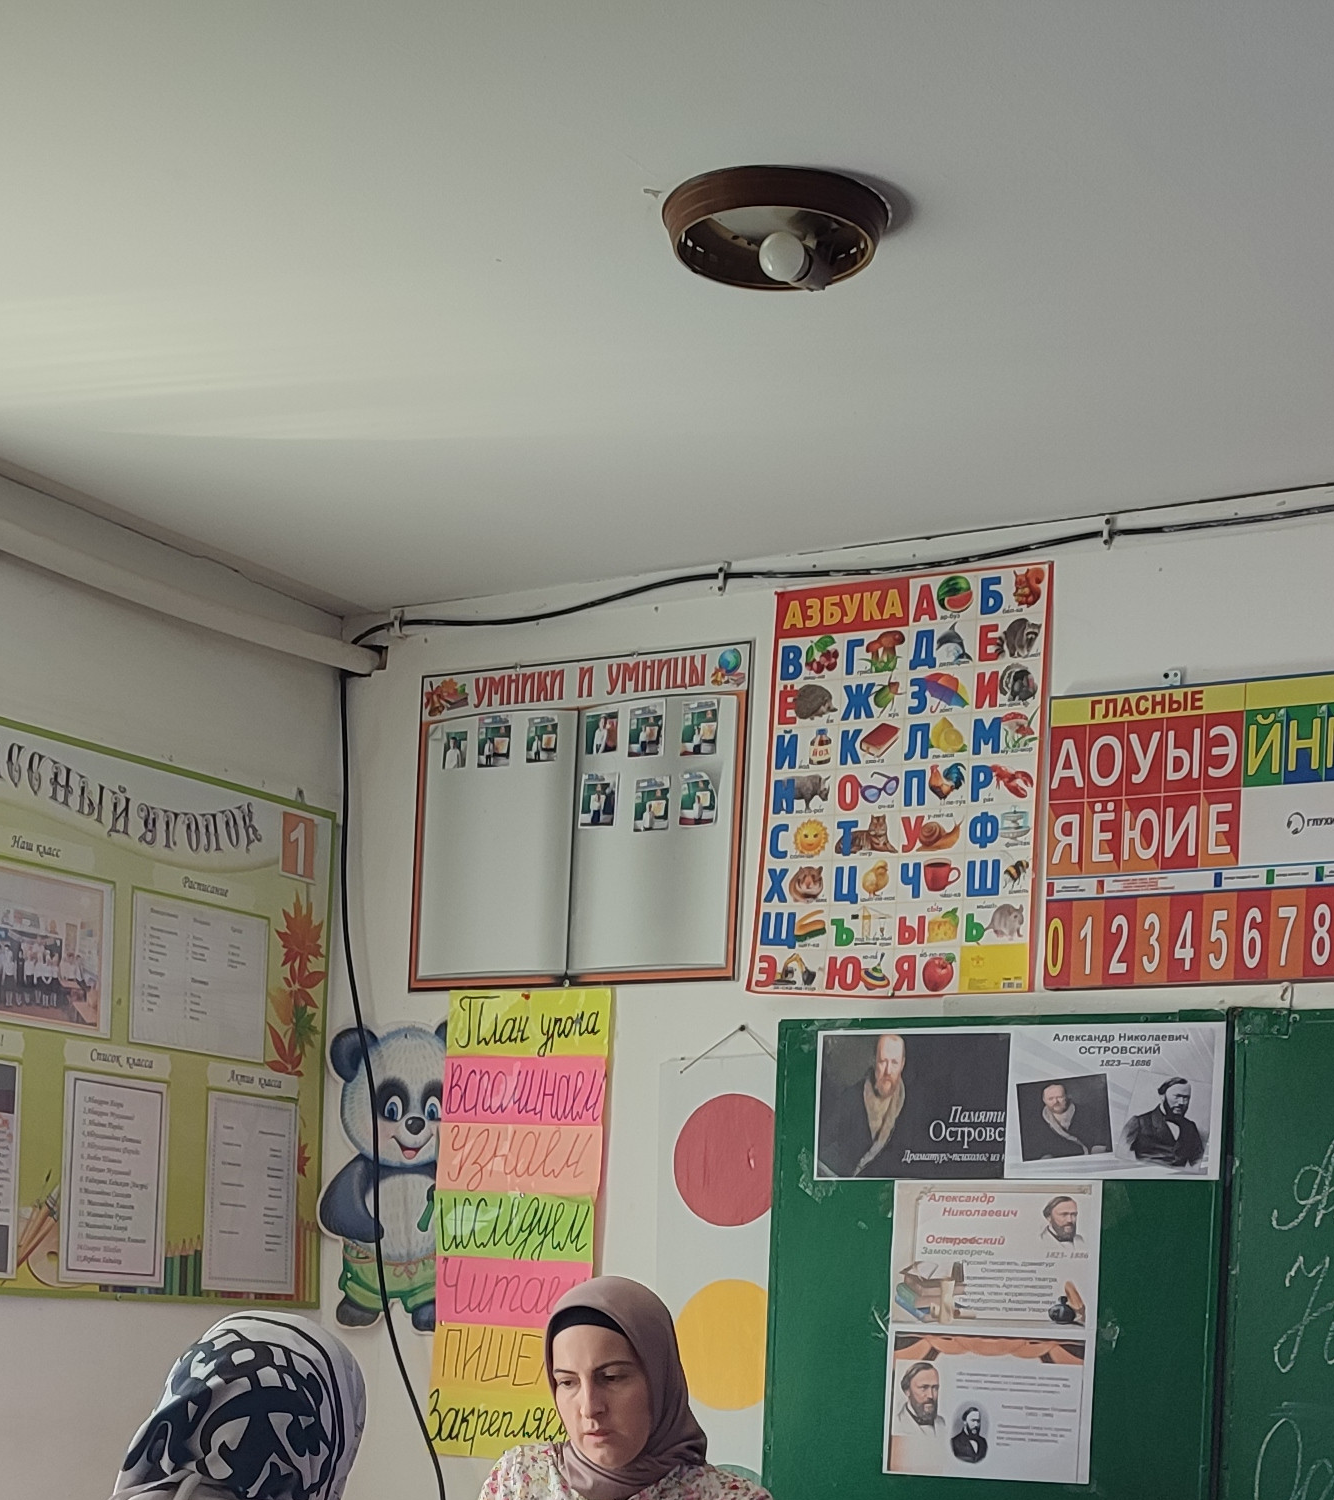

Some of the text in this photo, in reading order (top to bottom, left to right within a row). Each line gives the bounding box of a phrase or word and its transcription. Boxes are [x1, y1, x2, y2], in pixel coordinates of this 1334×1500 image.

[782, 576, 1003, 630] АЗБУКА А Б
[780, 623, 999, 681] В Г Д Е
[473, 653, 707, 709] УМНИКИ И УМНИЦЫ
[778, 670, 999, 725] Ё Ж З И
[1090, 689, 1204, 720] ГЛАСНЫЕ
[774, 716, 1002, 770] Й К Л М
[772, 764, 994, 815] Н О П Р
[11, 834, 61, 859] Наш класс
[137, 802, 263, 854] УГОЛОК
[769, 811, 999, 859] С Т У Ф
[182, 876, 229, 898] Расписание
[763, 859, 1001, 904] Х Ц Ч Ш
[759, 911, 985, 949] Щ Ъ Ы Ь
[1046, 917, 1064, 977] 0
[1079, 916, 1093, 975] 1
[1108, 914, 1129, 974] 2
[1141, 912, 1160, 973] 3
[1174, 910, 1194, 971] 4
[1208, 909, 1228, 970] 5
[1242, 907, 1263, 969] 6
[1278, 906, 1298, 967] 7
[1311, 903, 1332, 966] 8
[754, 954, 917, 992] Э Ю Я
[455, 995, 601, 1058] План урока
[1053, 1032, 1189, 1043] Александр Николаевич
[90, 1047, 154, 1069] Список класса
[1078, 1043, 1161, 1055] ОСТРОВСКИЙ
[227, 1069, 283, 1089] Актив класса
[929, 1119, 1007, 1149] Островс
[948, 1105, 1006, 1123] Памяти
[927, 1192, 996, 1205] Александр
[941, 1207, 1019, 1218] Николаевич
[442, 1256, 588, 1315] Читае
[442, 1327, 545, 1387] ПИШЕ
